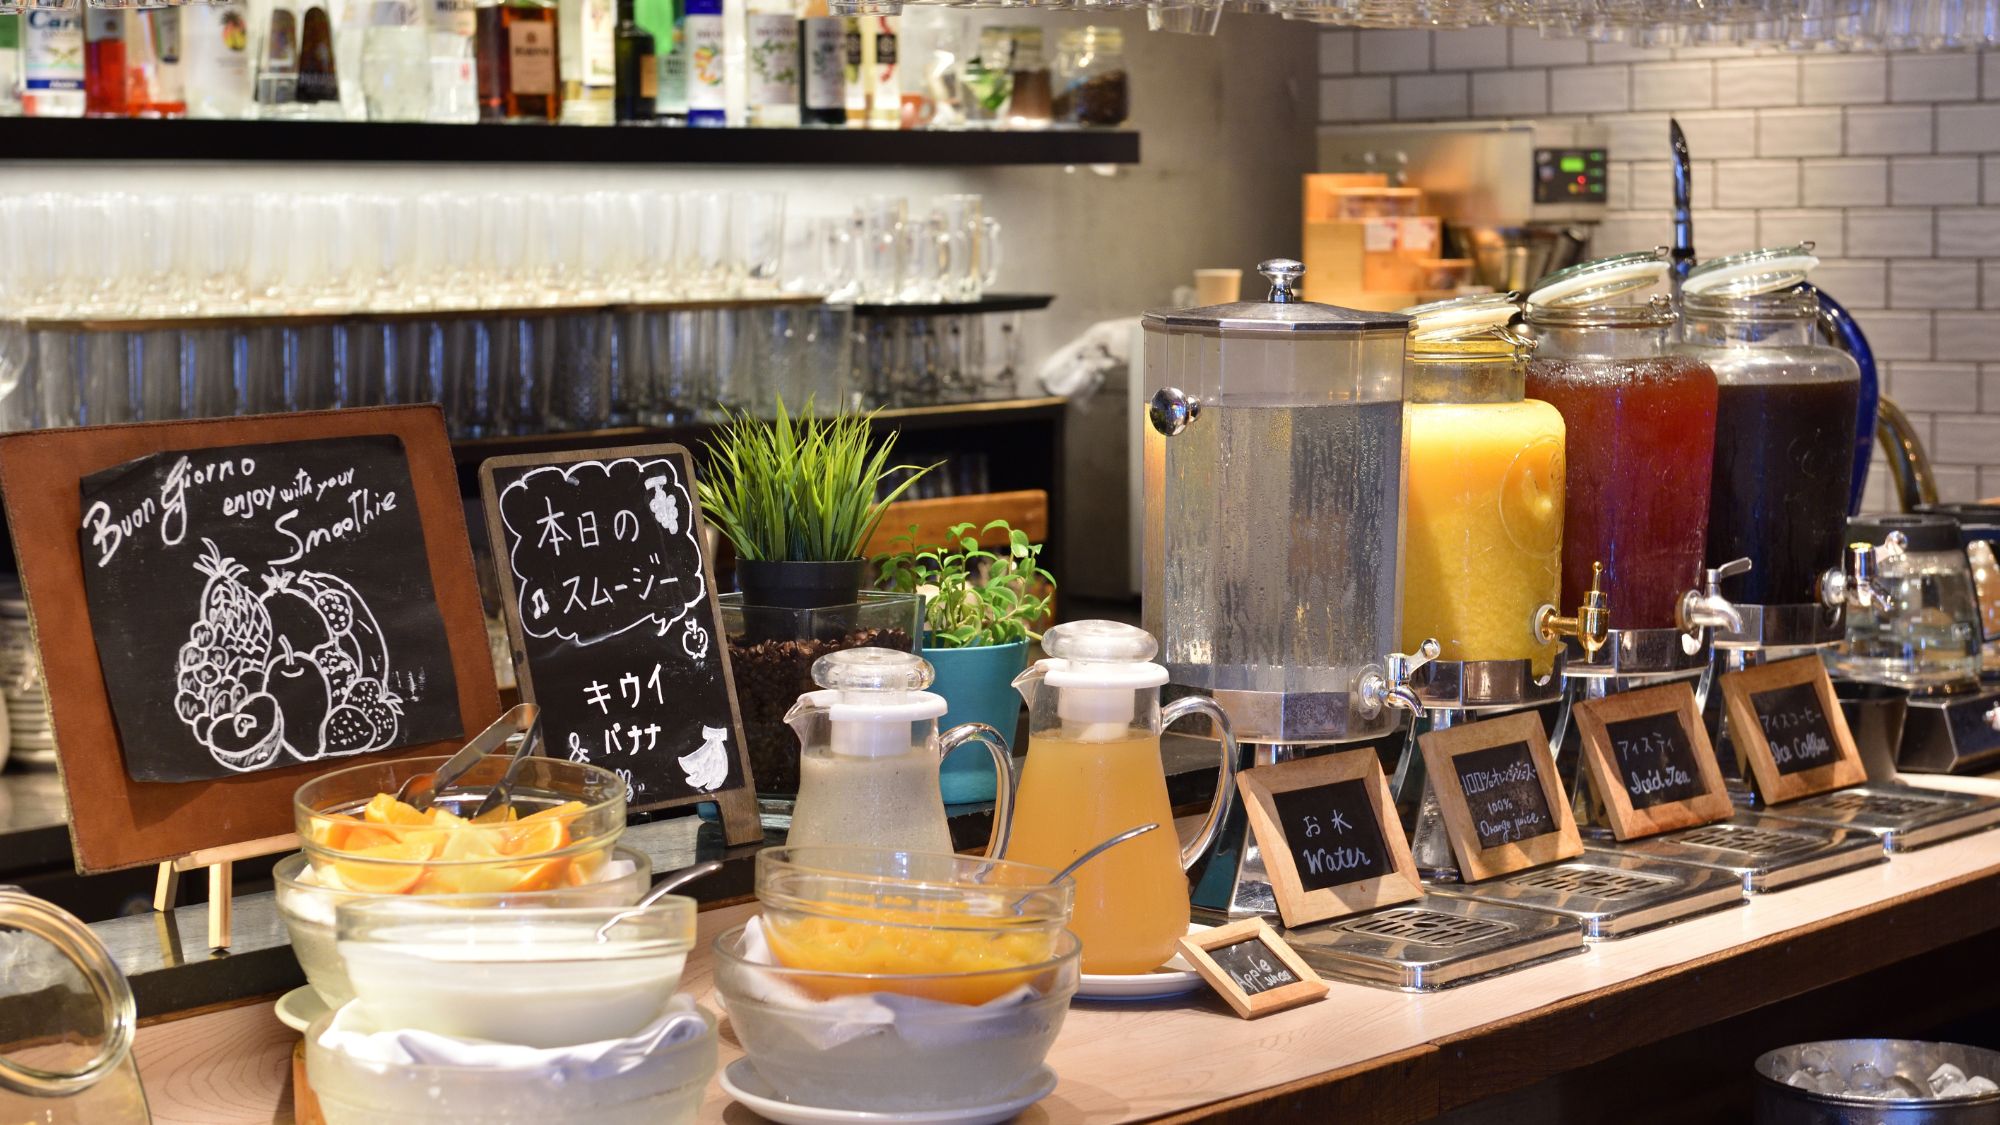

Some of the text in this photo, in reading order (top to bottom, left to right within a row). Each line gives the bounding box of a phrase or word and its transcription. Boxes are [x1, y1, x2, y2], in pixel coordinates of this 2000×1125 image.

[223, 467, 356, 518] enjoy with your
[83, 455, 256, 567] Buon Giorno
[536, 496, 640, 556] 本日の
[562, 552, 679, 615] スムージー
[583, 662, 664, 714] キウイ
[604, 722, 661, 756] バナナ
[1665, 765, 1691, 787] Tea
[1303, 809, 1353, 838] お水
[1487, 798, 1514, 816] 100%
[1480, 819, 1512, 843] Orange
[1303, 846, 1371, 875] Water
[1230, 955, 1272, 993] Apple
